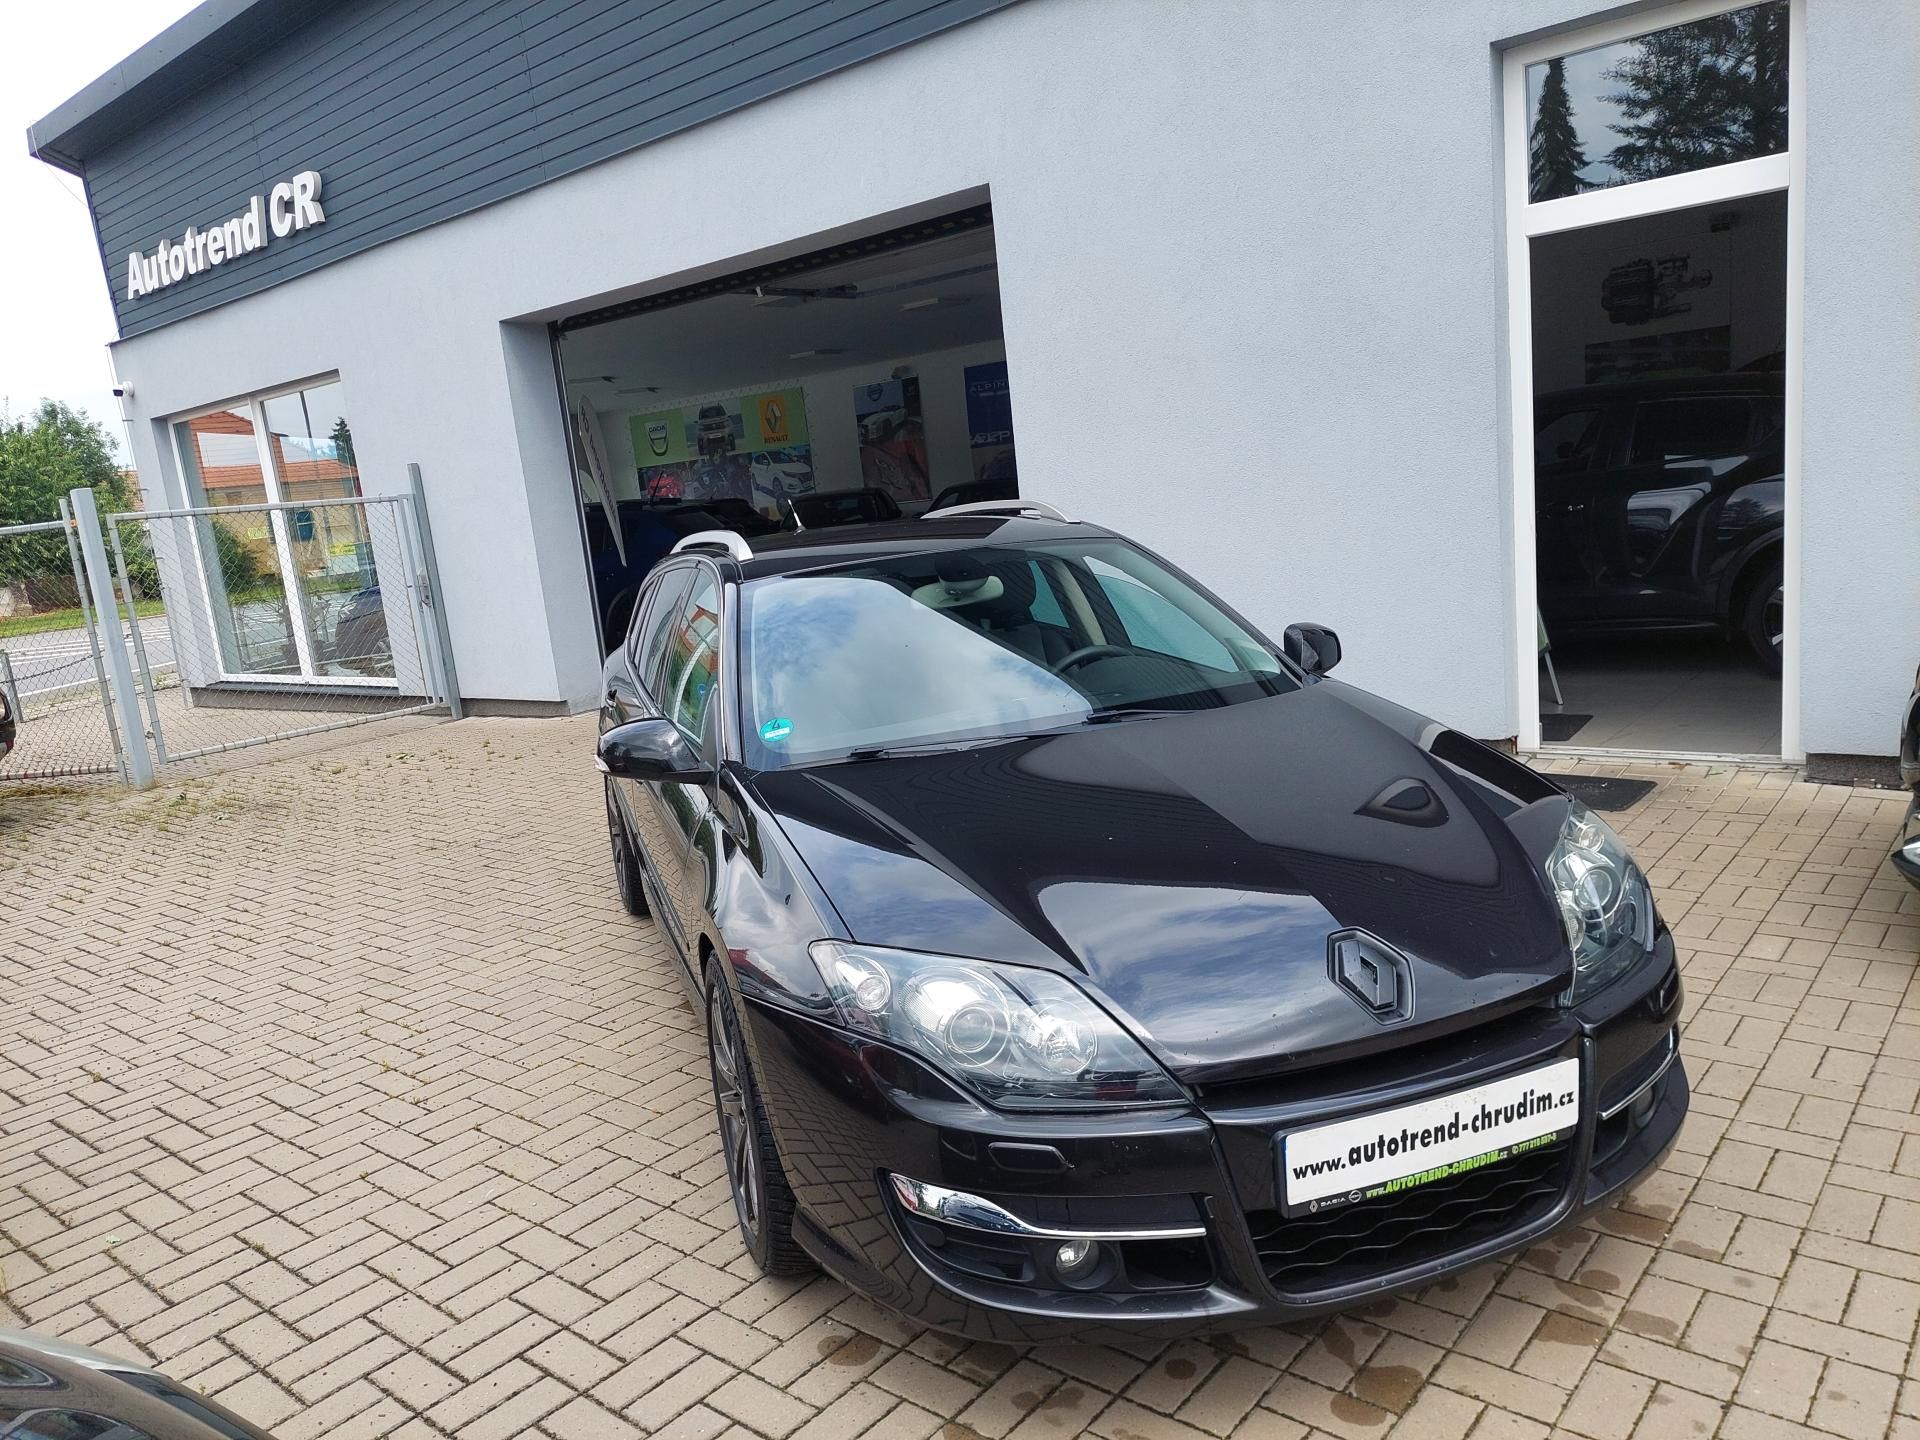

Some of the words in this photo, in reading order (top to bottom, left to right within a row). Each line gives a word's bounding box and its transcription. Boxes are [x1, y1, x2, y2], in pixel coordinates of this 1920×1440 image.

[128, 195, 267, 300] Autotrend
[269, 170, 325, 238] CR
[1293, 1089, 1575, 1180] www.autotrend-chrudim.cz
[1365, 1150, 1508, 1198] www.AUTOTREND-CHRUDIM.cz
